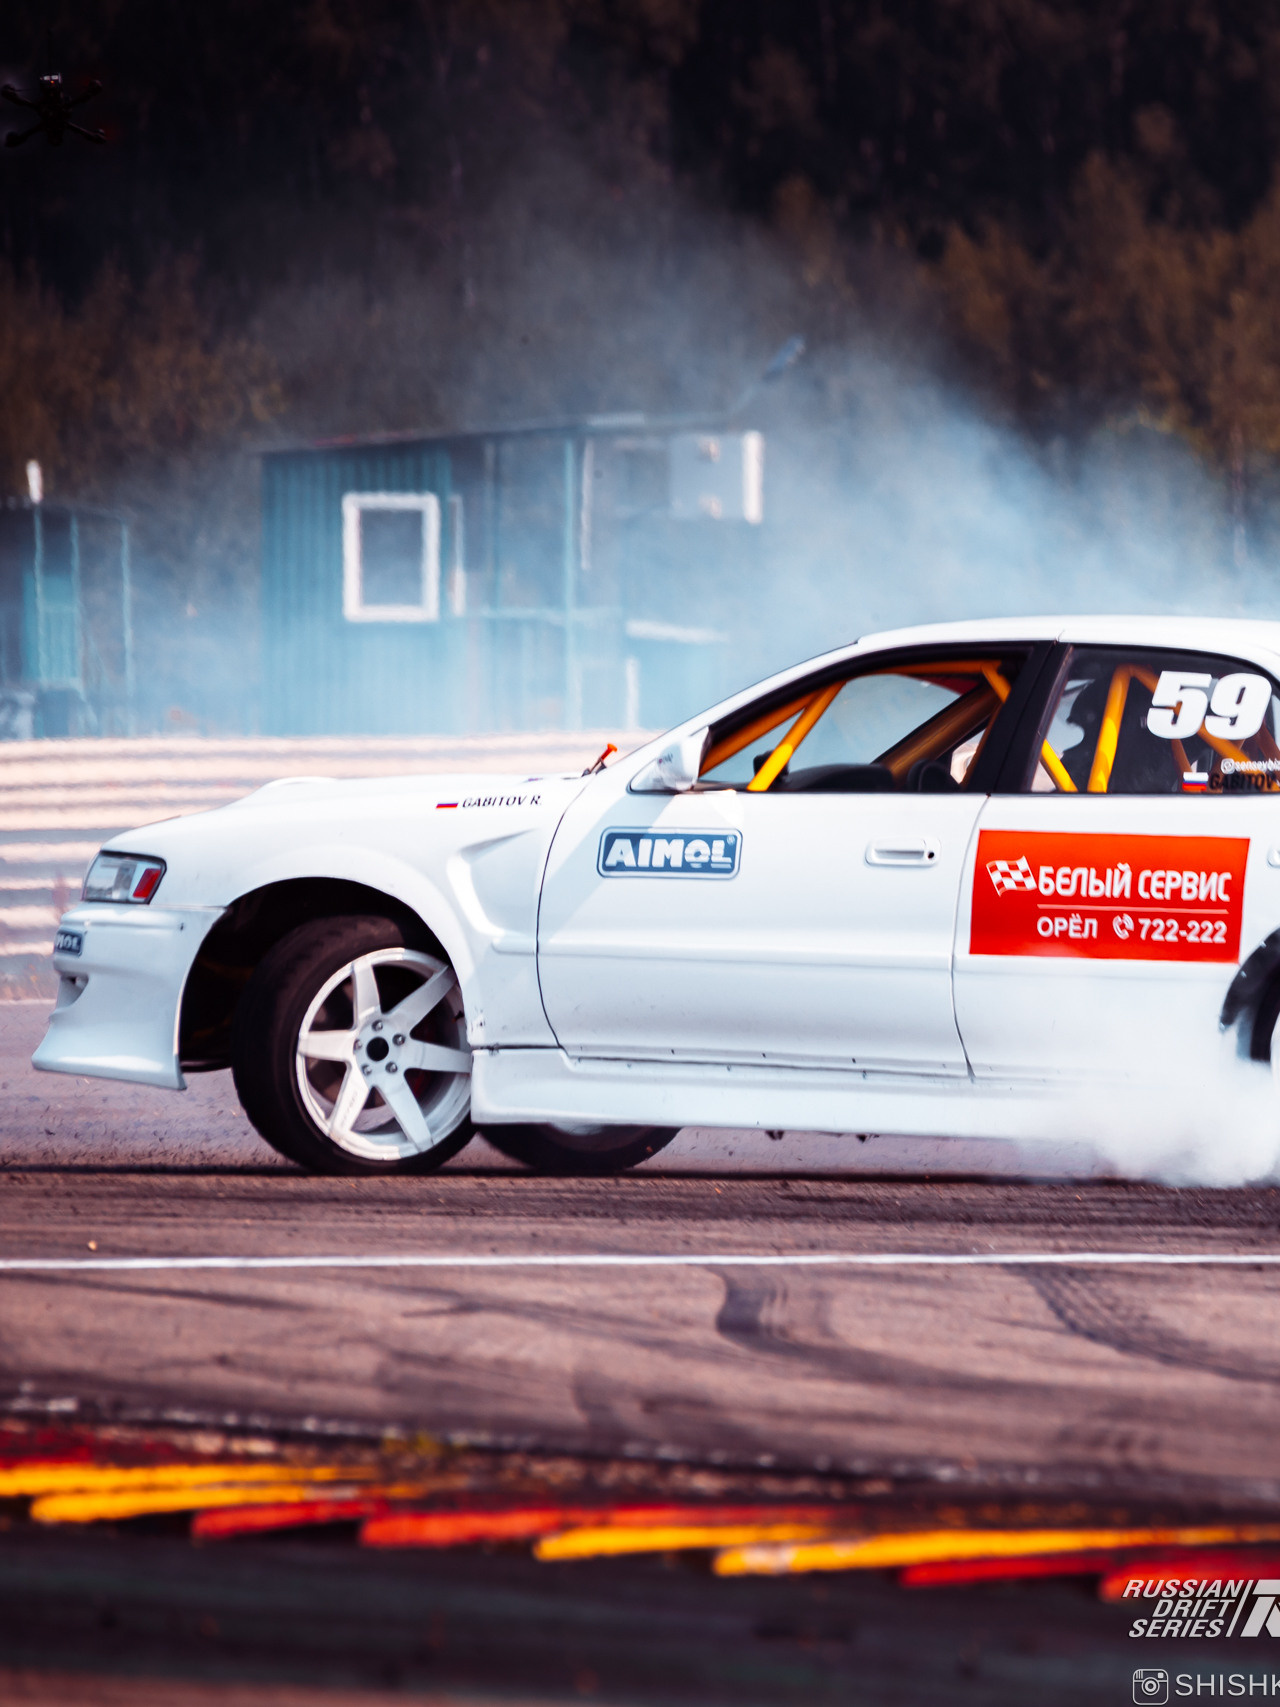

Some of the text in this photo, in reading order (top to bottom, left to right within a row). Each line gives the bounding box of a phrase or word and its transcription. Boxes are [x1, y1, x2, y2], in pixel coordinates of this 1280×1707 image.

[1146, 670, 1272, 740] 59
[1209, 773, 1277, 790] GABITOV
[463, 796, 526, 809] GABITOV
[1037, 863, 1232, 902] БЕЛЫЙ СЕРВИС
[1036, 913, 1228, 944] ОРЁЛ 722-222
